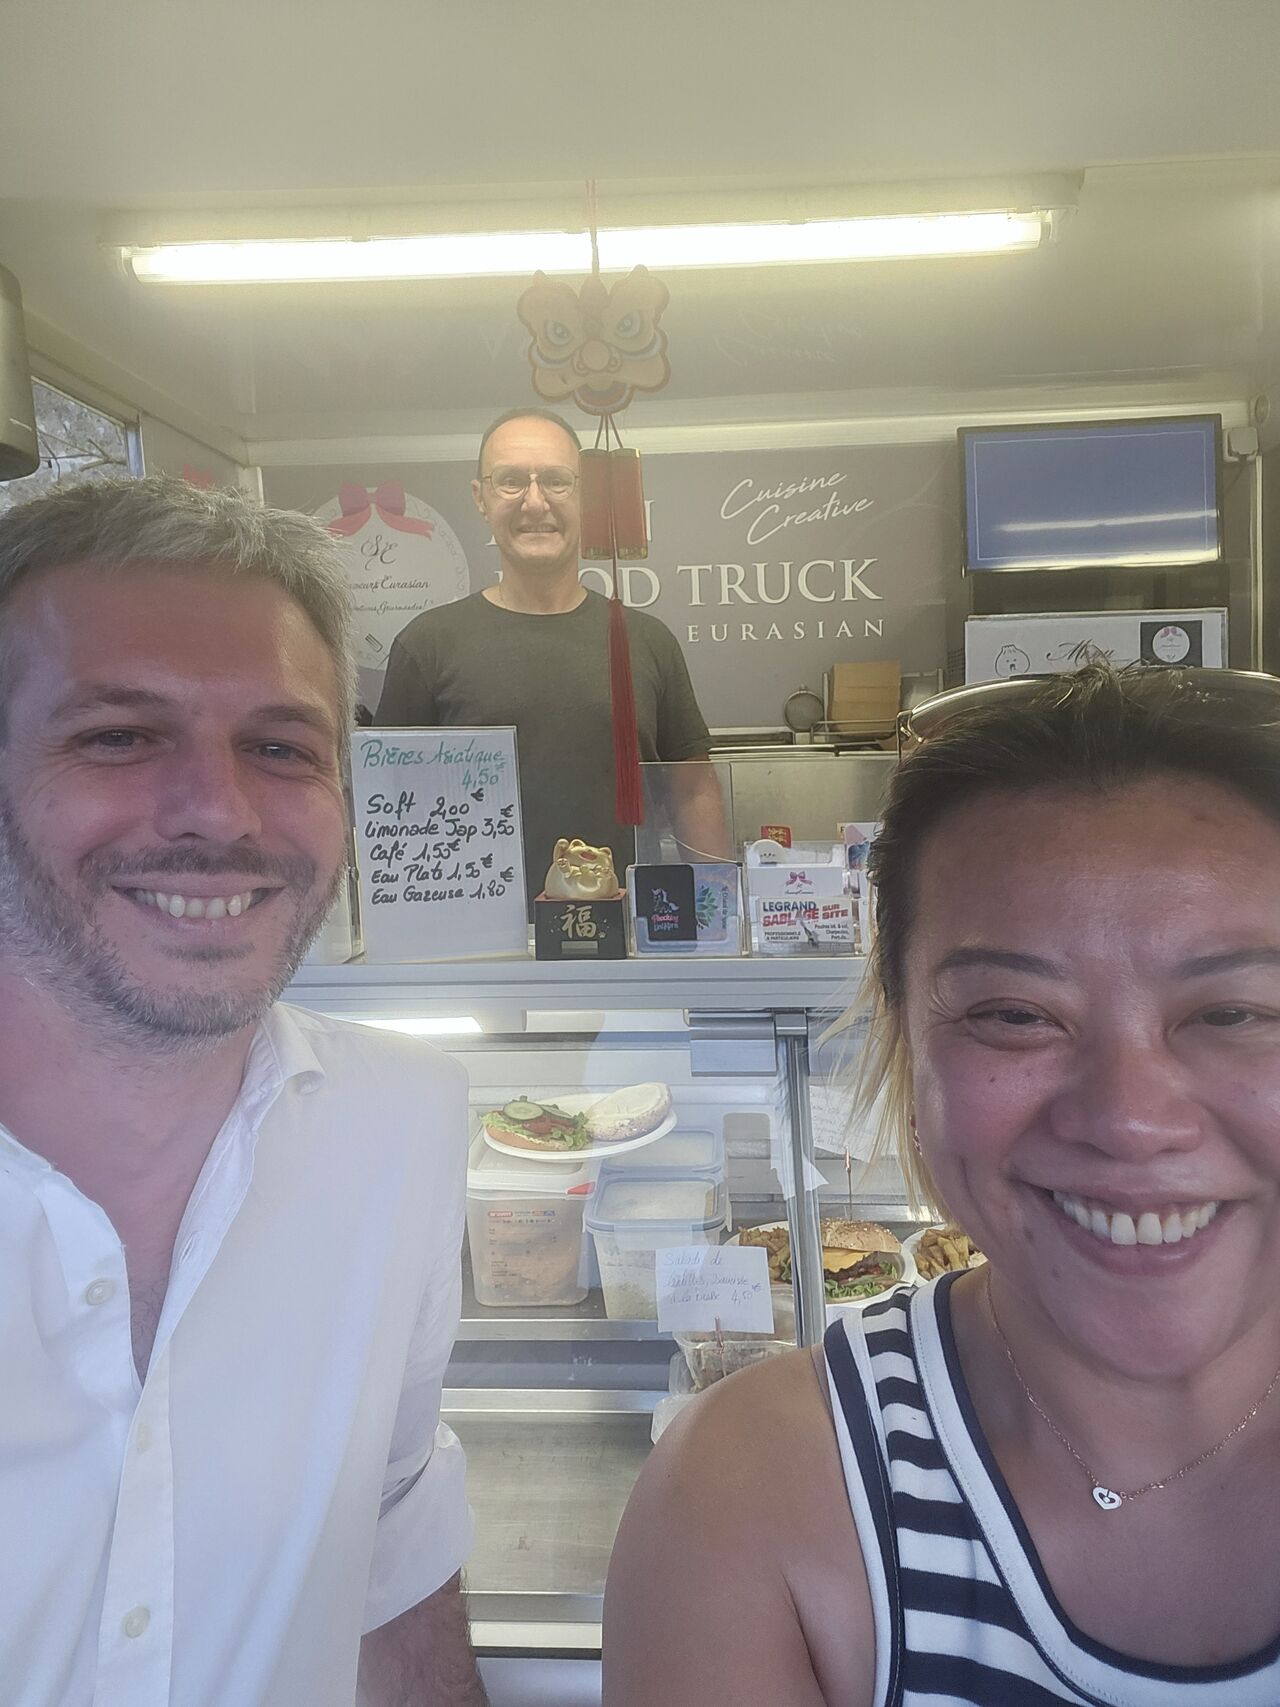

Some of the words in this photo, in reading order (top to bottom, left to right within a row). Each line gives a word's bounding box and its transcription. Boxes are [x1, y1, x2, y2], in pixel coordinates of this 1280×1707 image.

[720, 472, 848, 520] Cuisine
[747, 491, 874, 545] Creative
[381, 575, 429, 590] Eurasian
[676, 558, 884, 607] TRUCK
[687, 619, 884, 643] EURASIAN
[366, 790, 416, 820] Soft
[444, 818, 478, 843] Jap
[370, 840, 408, 868] Café
[371, 869, 400, 884] Eau
[371, 888, 398, 905] Eau
[403, 885, 465, 903] Gazeuse
[762, 901, 817, 912] LEGRAND
